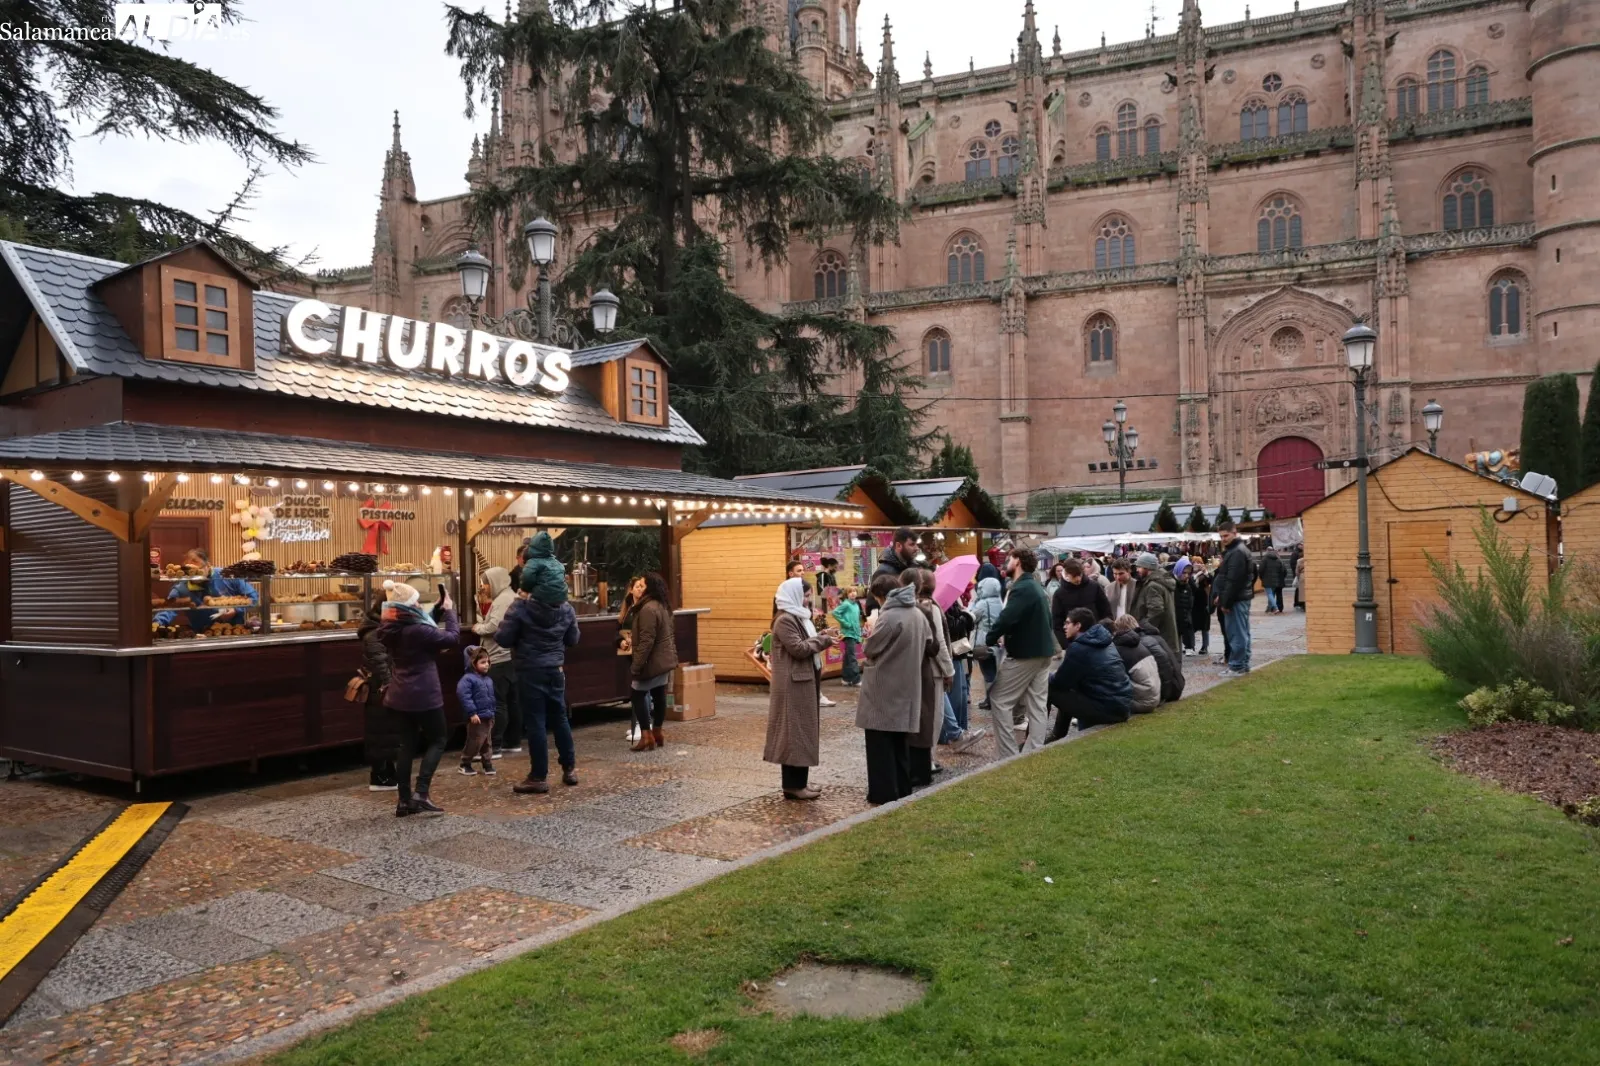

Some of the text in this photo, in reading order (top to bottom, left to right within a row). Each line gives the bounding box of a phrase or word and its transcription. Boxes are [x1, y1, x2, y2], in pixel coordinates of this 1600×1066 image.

[287, 299, 572, 392] CHURROS
[165, 498, 225, 511] ELLENOS
[284, 496, 321, 507] DULCE
[275, 507, 330, 518] DE LECHE
[361, 509, 416, 520] PISTACHO
